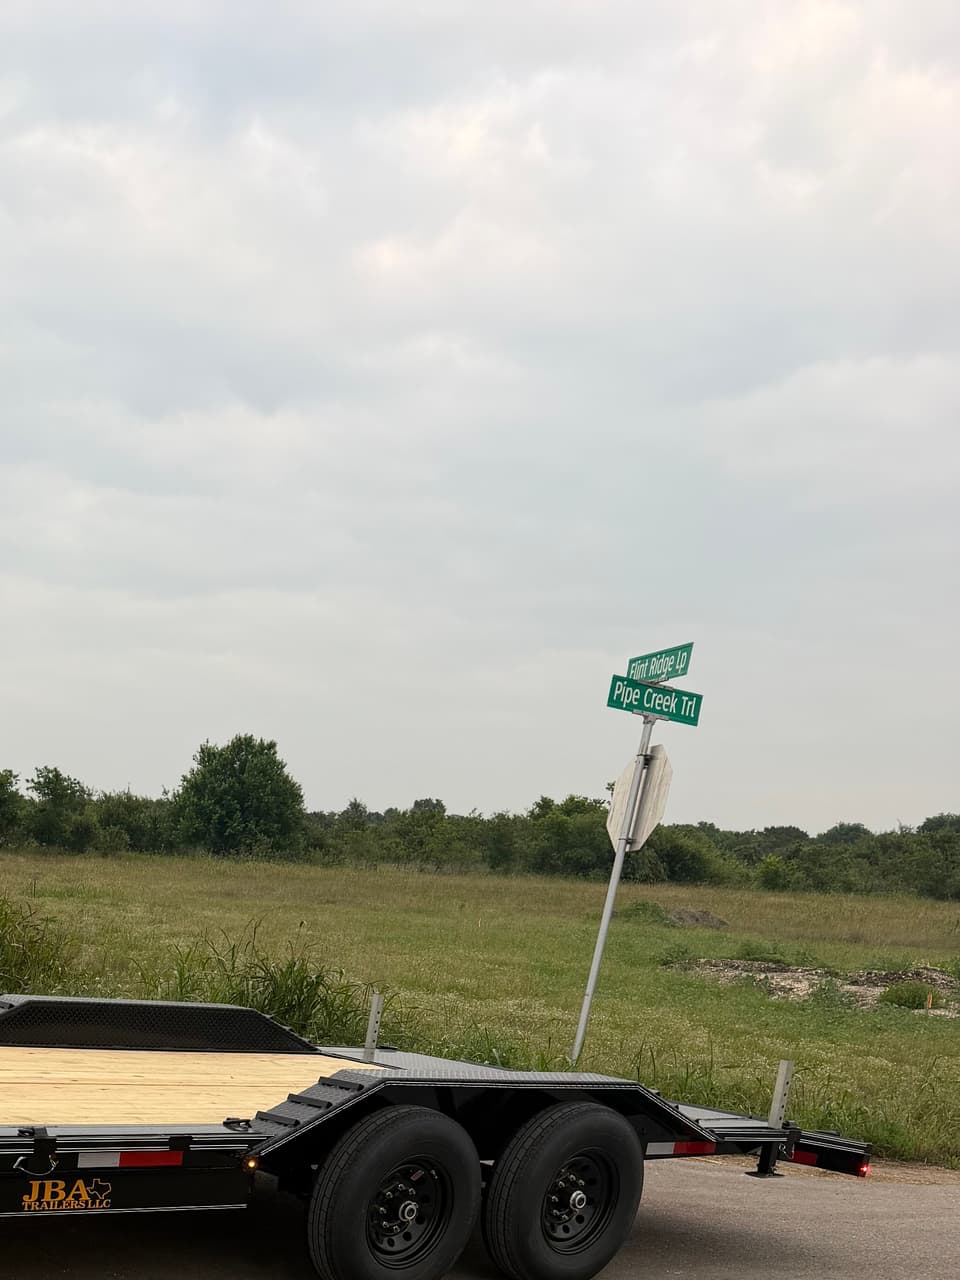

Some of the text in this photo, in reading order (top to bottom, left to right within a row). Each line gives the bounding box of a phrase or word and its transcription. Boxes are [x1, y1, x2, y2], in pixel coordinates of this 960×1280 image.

[630, 651, 687, 679] Flint Ridge Lp
[613, 681, 696, 717] Pipe Creek Trl
[22, 1179, 90, 1202] JBA
[22, 1199, 111, 1211] TRAILERS LLC
